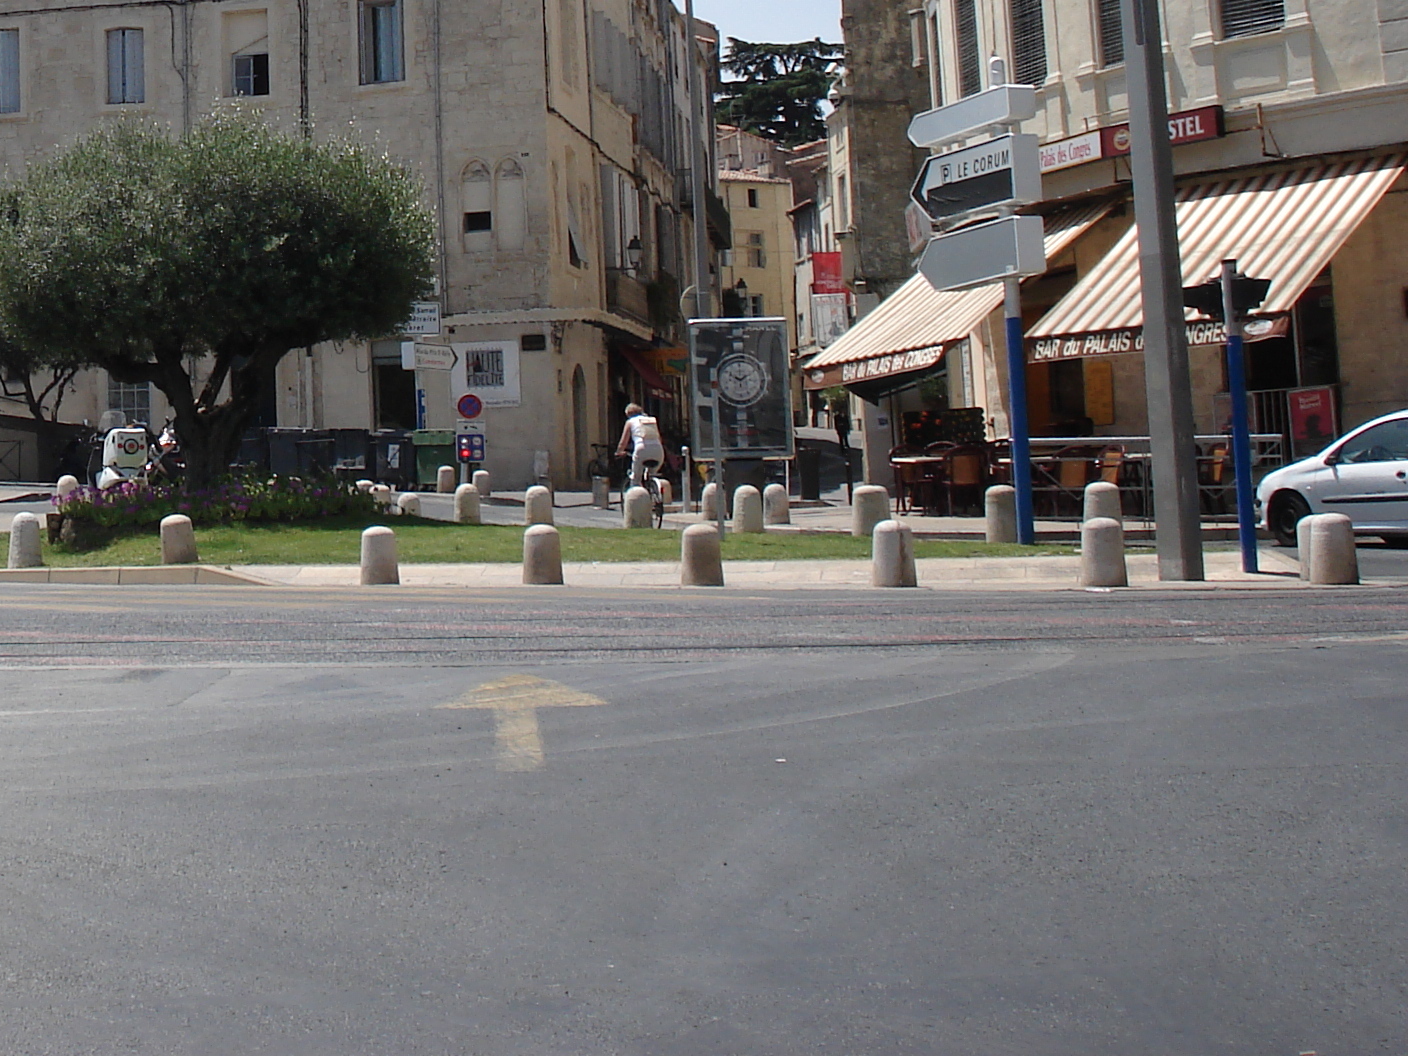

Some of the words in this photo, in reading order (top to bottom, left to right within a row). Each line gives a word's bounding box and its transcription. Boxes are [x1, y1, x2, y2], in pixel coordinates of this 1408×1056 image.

[1167, 115, 1205, 140] STEL
[956, 161, 968, 178] LE
[973, 149, 1009, 174] CORUM
[1034, 338, 1060, 360] BAR
[1063, 337, 1081, 356] du
[1083, 330, 1132, 355] PALAIS
[1185, 321, 1228, 345] NGRES
[465, 350, 504, 373] HAUTE
[842, 361, 857, 382] BAR
[866, 355, 891, 377] PALAIS
